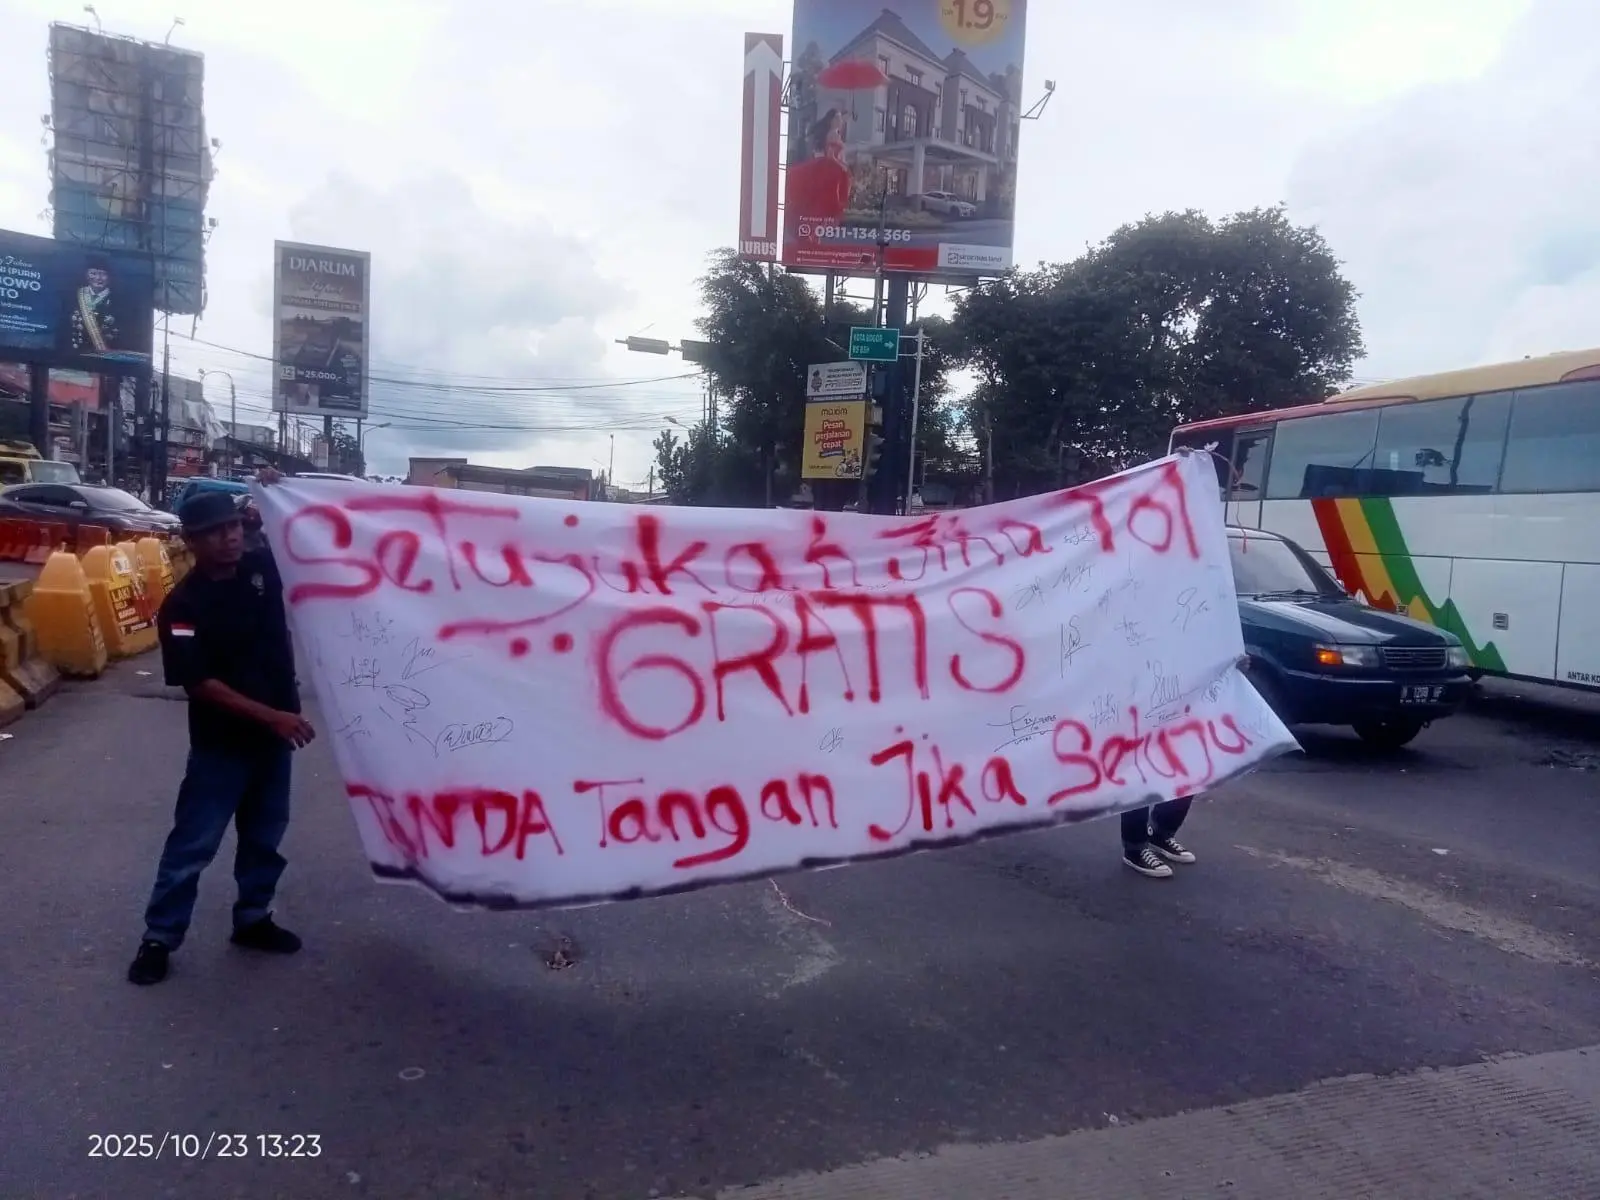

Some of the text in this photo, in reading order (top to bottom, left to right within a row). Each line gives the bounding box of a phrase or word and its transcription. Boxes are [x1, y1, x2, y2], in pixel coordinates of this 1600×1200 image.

[739, 240, 776, 255] LURUS
[823, 421, 844, 430] Pesan
[823, 441, 842, 449] cepat
[1568, 671, 1591, 681] ANTAR
[573, 774, 838, 869] Tangan
